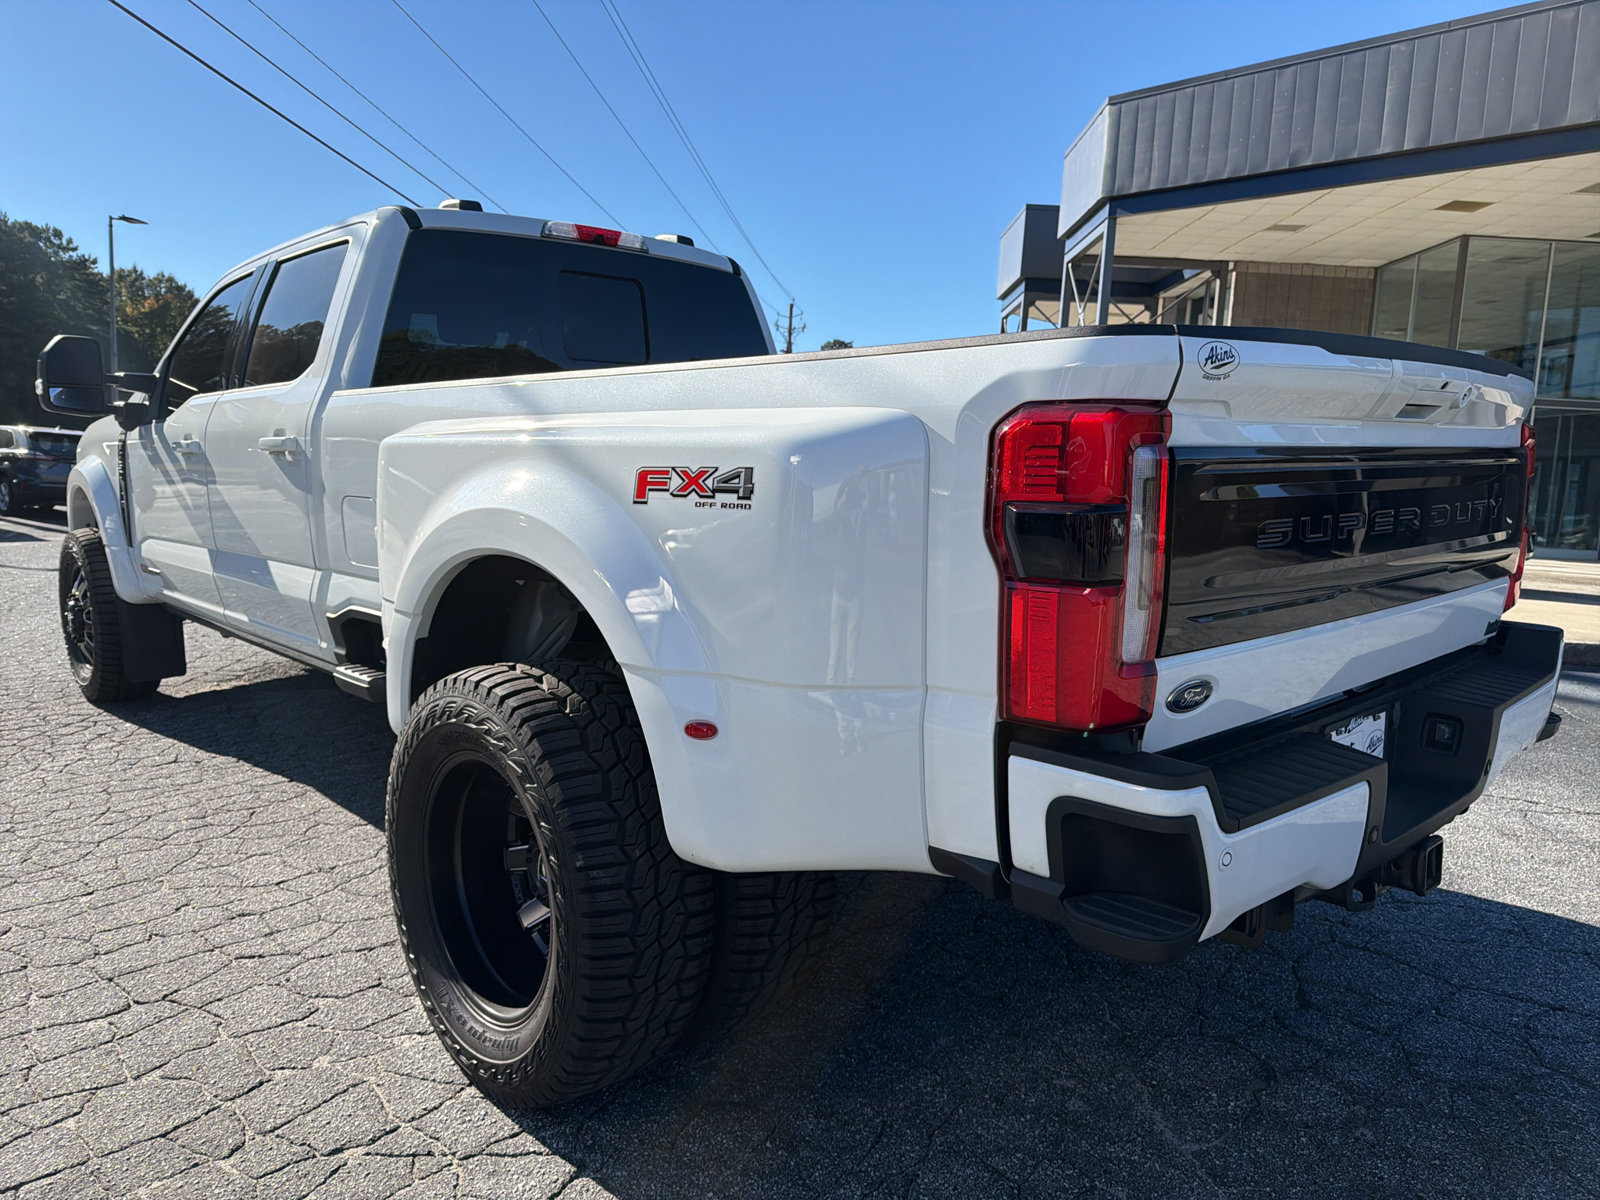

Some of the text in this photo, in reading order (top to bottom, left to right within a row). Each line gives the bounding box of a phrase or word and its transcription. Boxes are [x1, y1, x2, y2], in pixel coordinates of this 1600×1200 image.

[1203, 344, 1236, 369] Akins
[632, 466, 754, 505] FX4
[694, 501, 752, 510] OFF ROAD
[1256, 498, 1503, 549] SUPER DUTY
[1180, 687, 1207, 706] Ford
